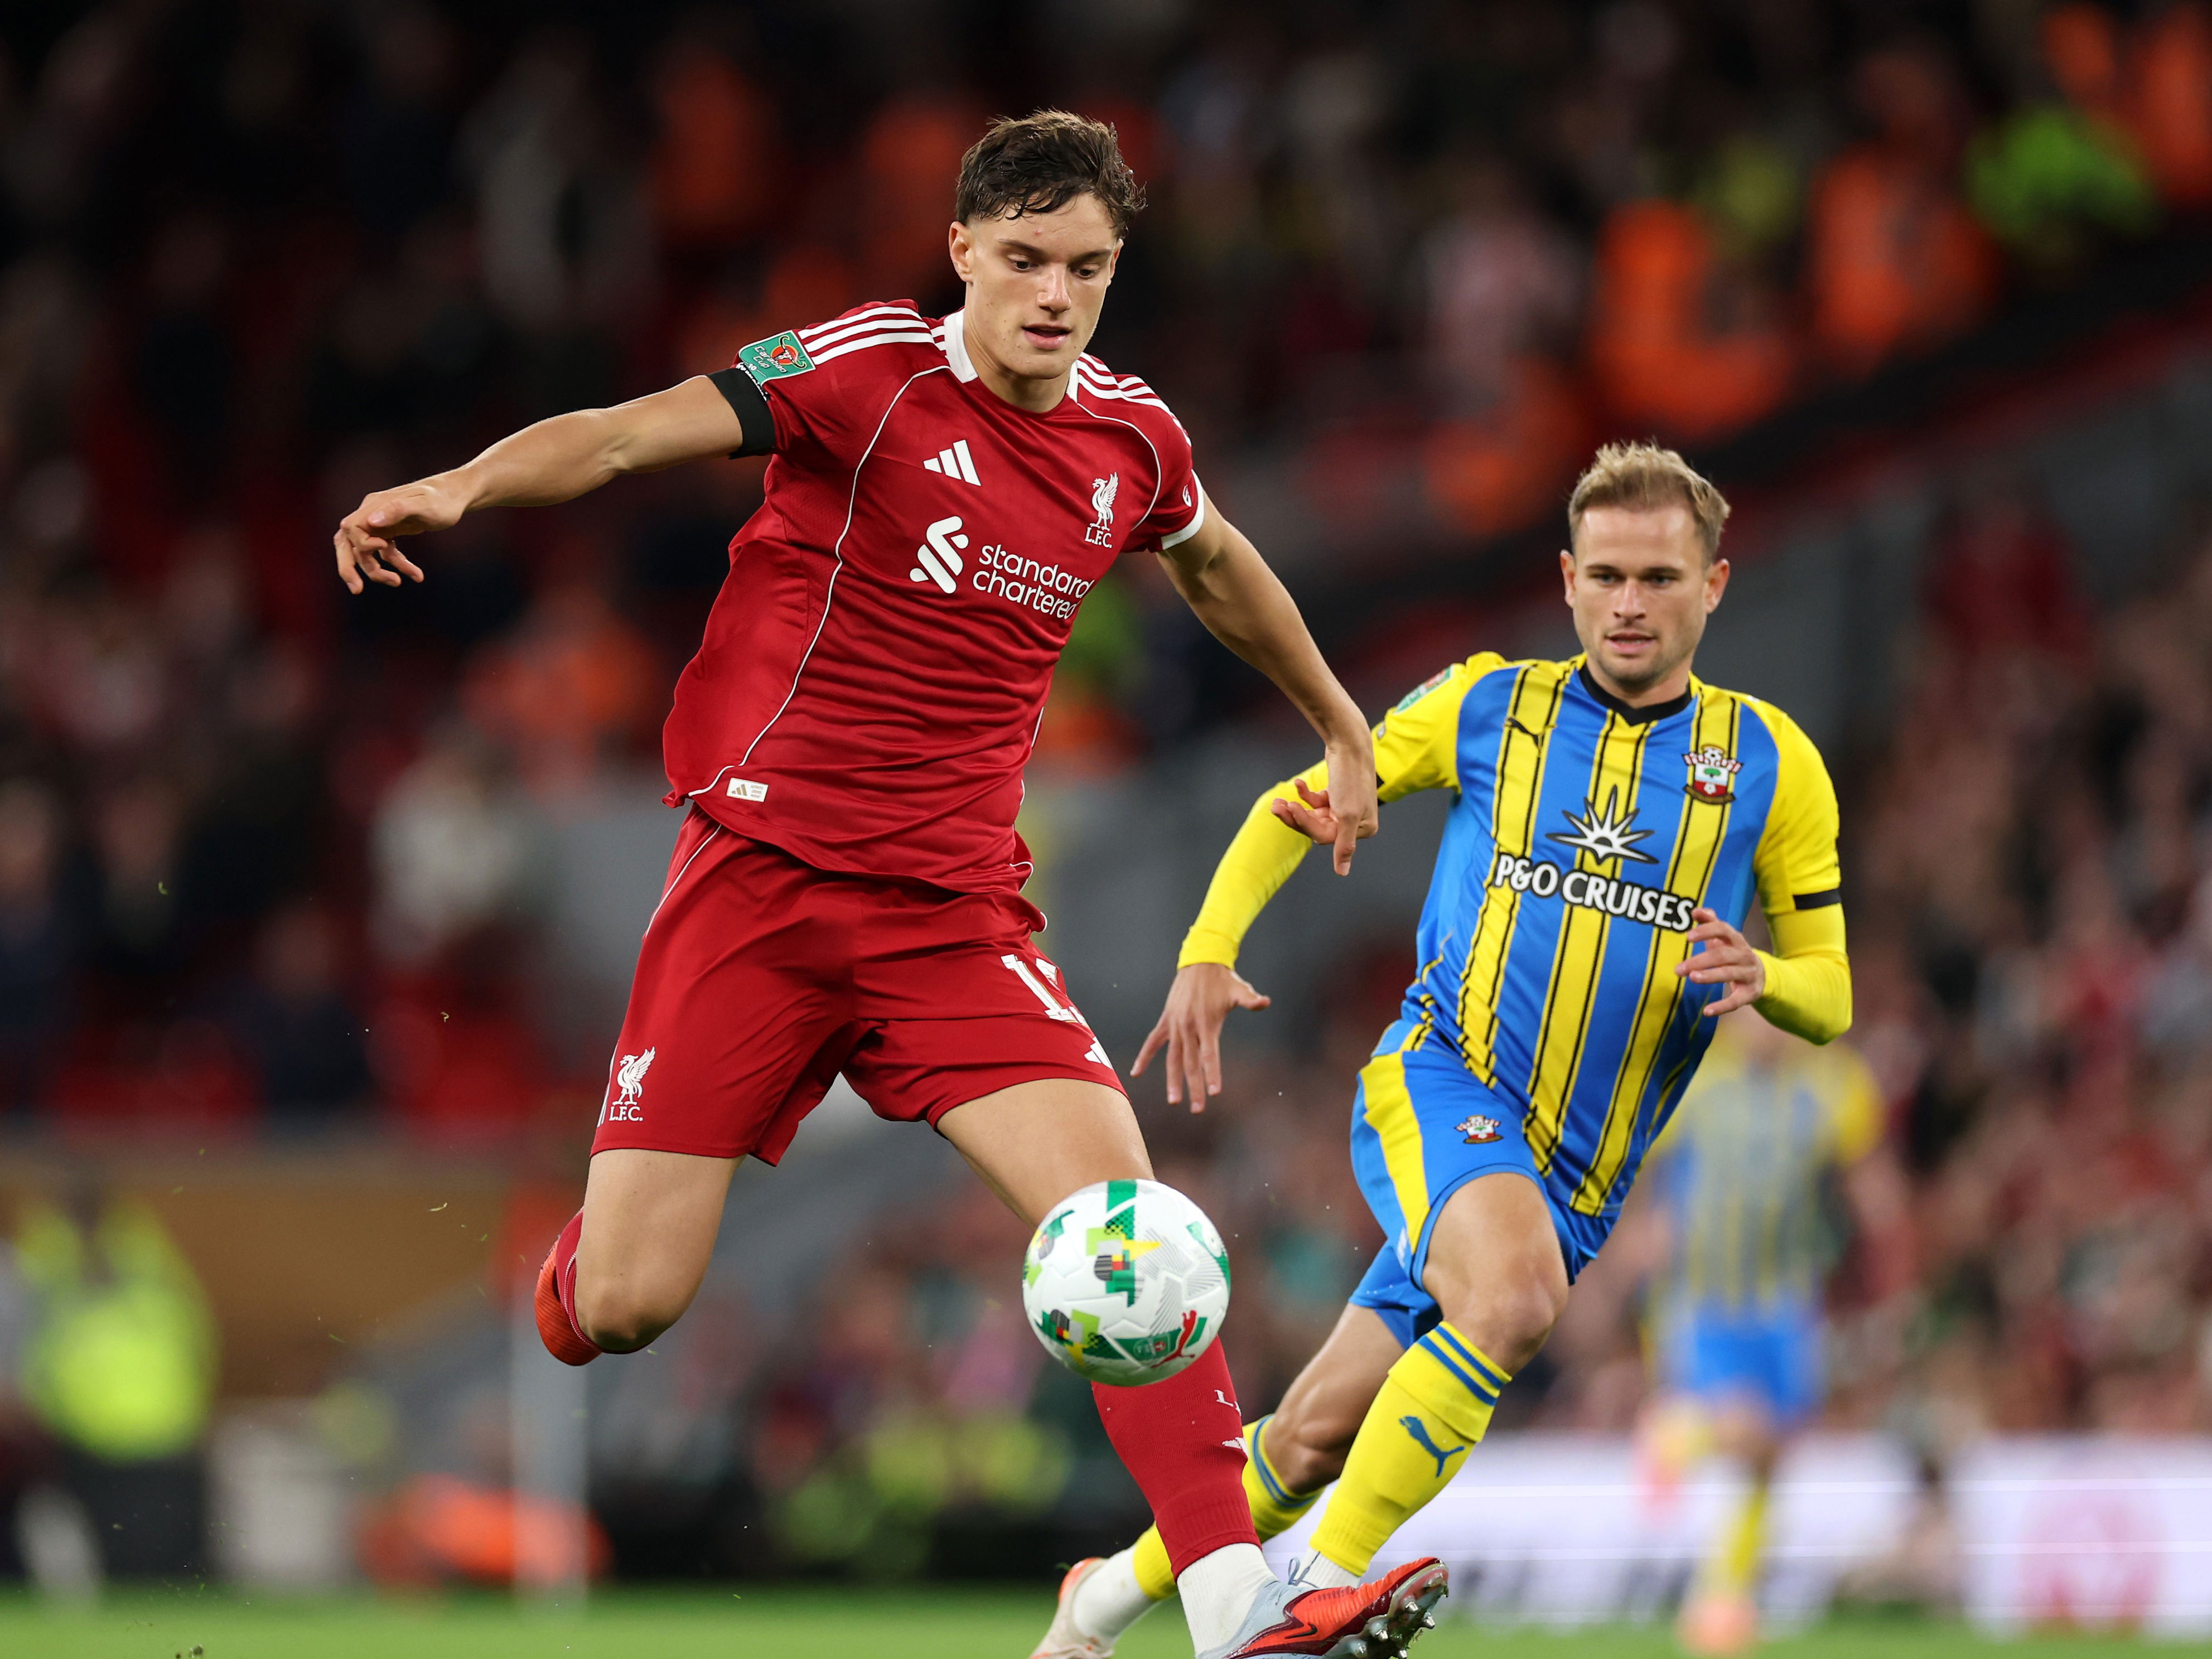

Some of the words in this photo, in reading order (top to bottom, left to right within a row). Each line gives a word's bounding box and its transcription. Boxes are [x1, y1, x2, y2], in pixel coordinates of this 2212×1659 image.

[753, 356, 770, 368] Cup
[754, 346, 787, 373] Carabao
[1084, 527, 1112, 548] L.F.C.
[979, 544, 1095, 598] standard
[1494, 854, 1559, 896] P&O
[1562, 871, 1695, 931] CRUISES
[609, 1106, 643, 1121] L.F.C.
